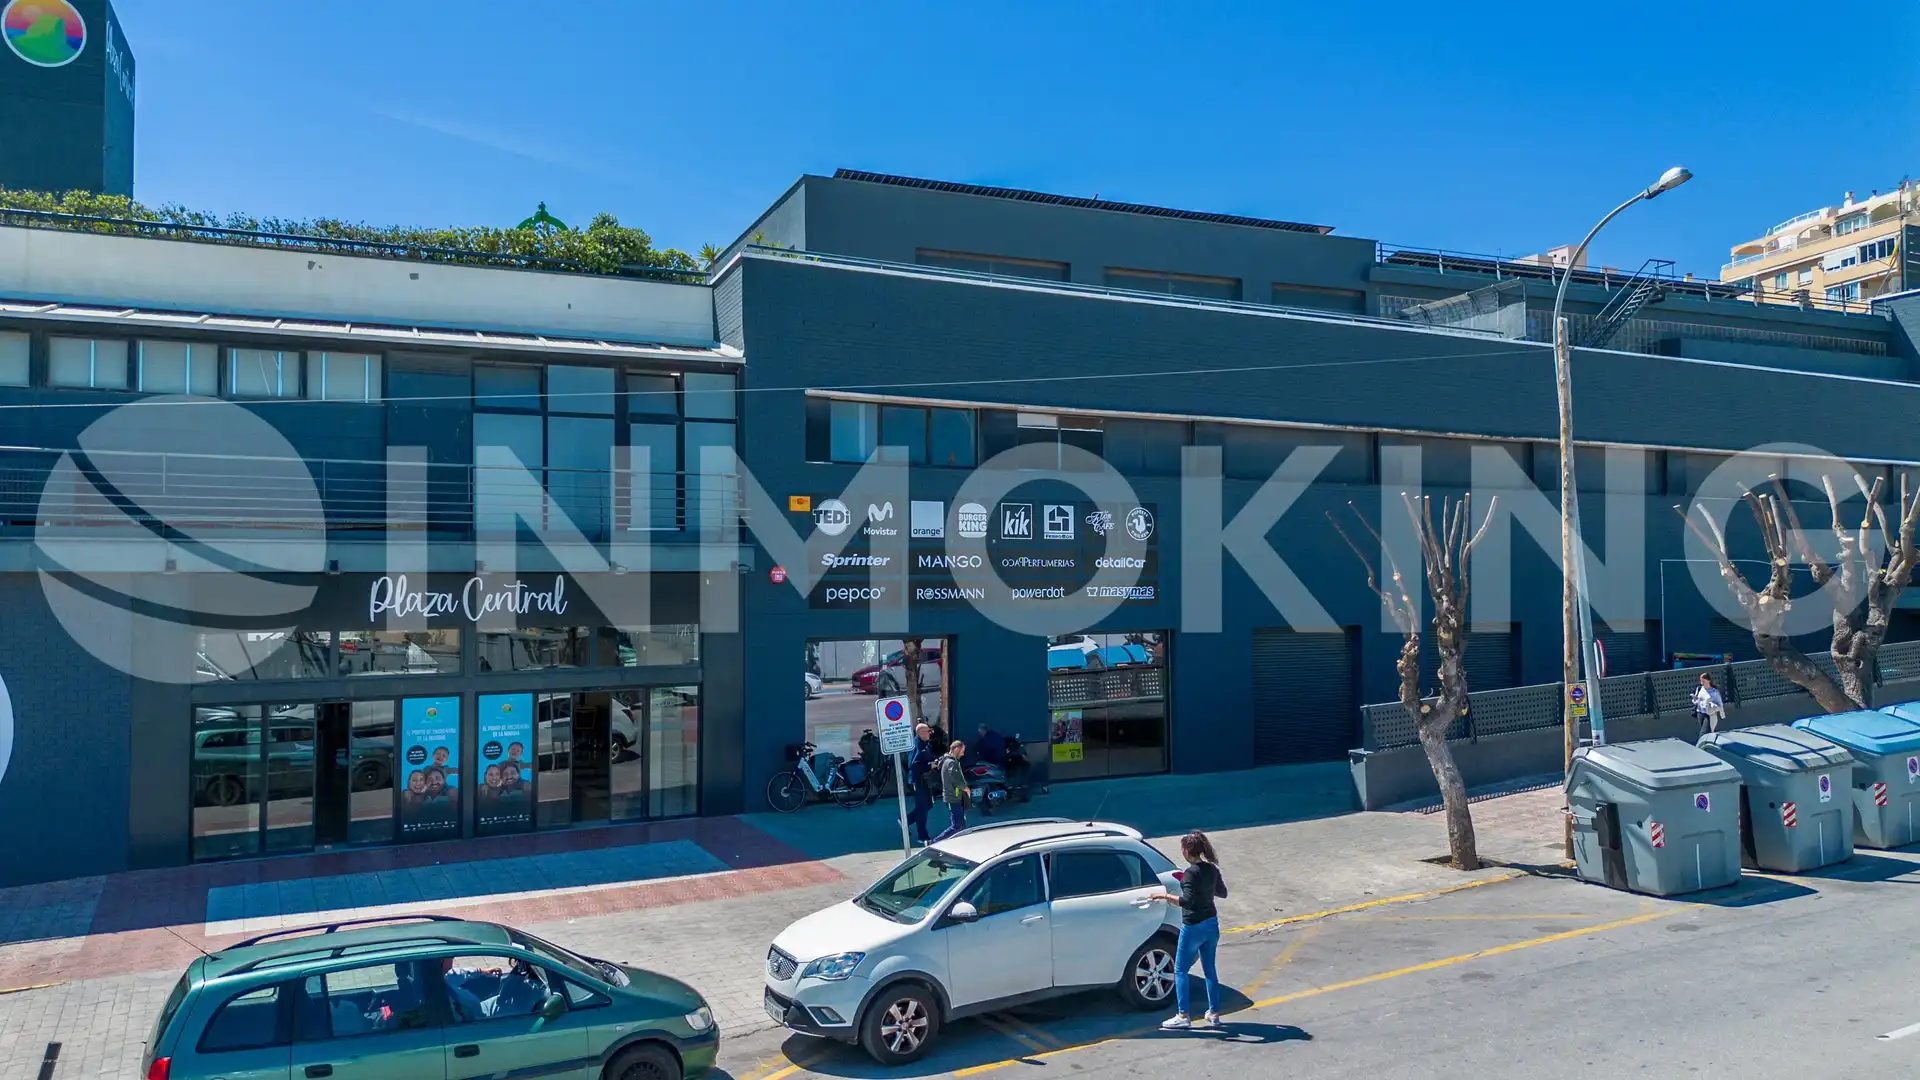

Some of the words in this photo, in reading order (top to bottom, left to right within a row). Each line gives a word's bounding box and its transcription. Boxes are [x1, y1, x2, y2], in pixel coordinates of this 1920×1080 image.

[812, 508, 851, 526] TEDi
[959, 513, 987, 521] BURGER
[1004, 506, 1030, 536] kik
[863, 527, 898, 536] Movistar
[913, 527, 941, 536] orange
[959, 521, 987, 532] KING
[821, 553, 890, 568] Sprinter
[918, 555, 982, 568] MANGO
[1095, 557, 1146, 568] detailCar
[369, 574, 459, 622] Plaza
[462, 574, 568, 622] Central
[826, 587, 881, 602] pepco
[916, 588, 985, 600] ROSSMANN
[1012, 586, 1065, 600] powerdot
[1100, 586, 1154, 599] masymas
